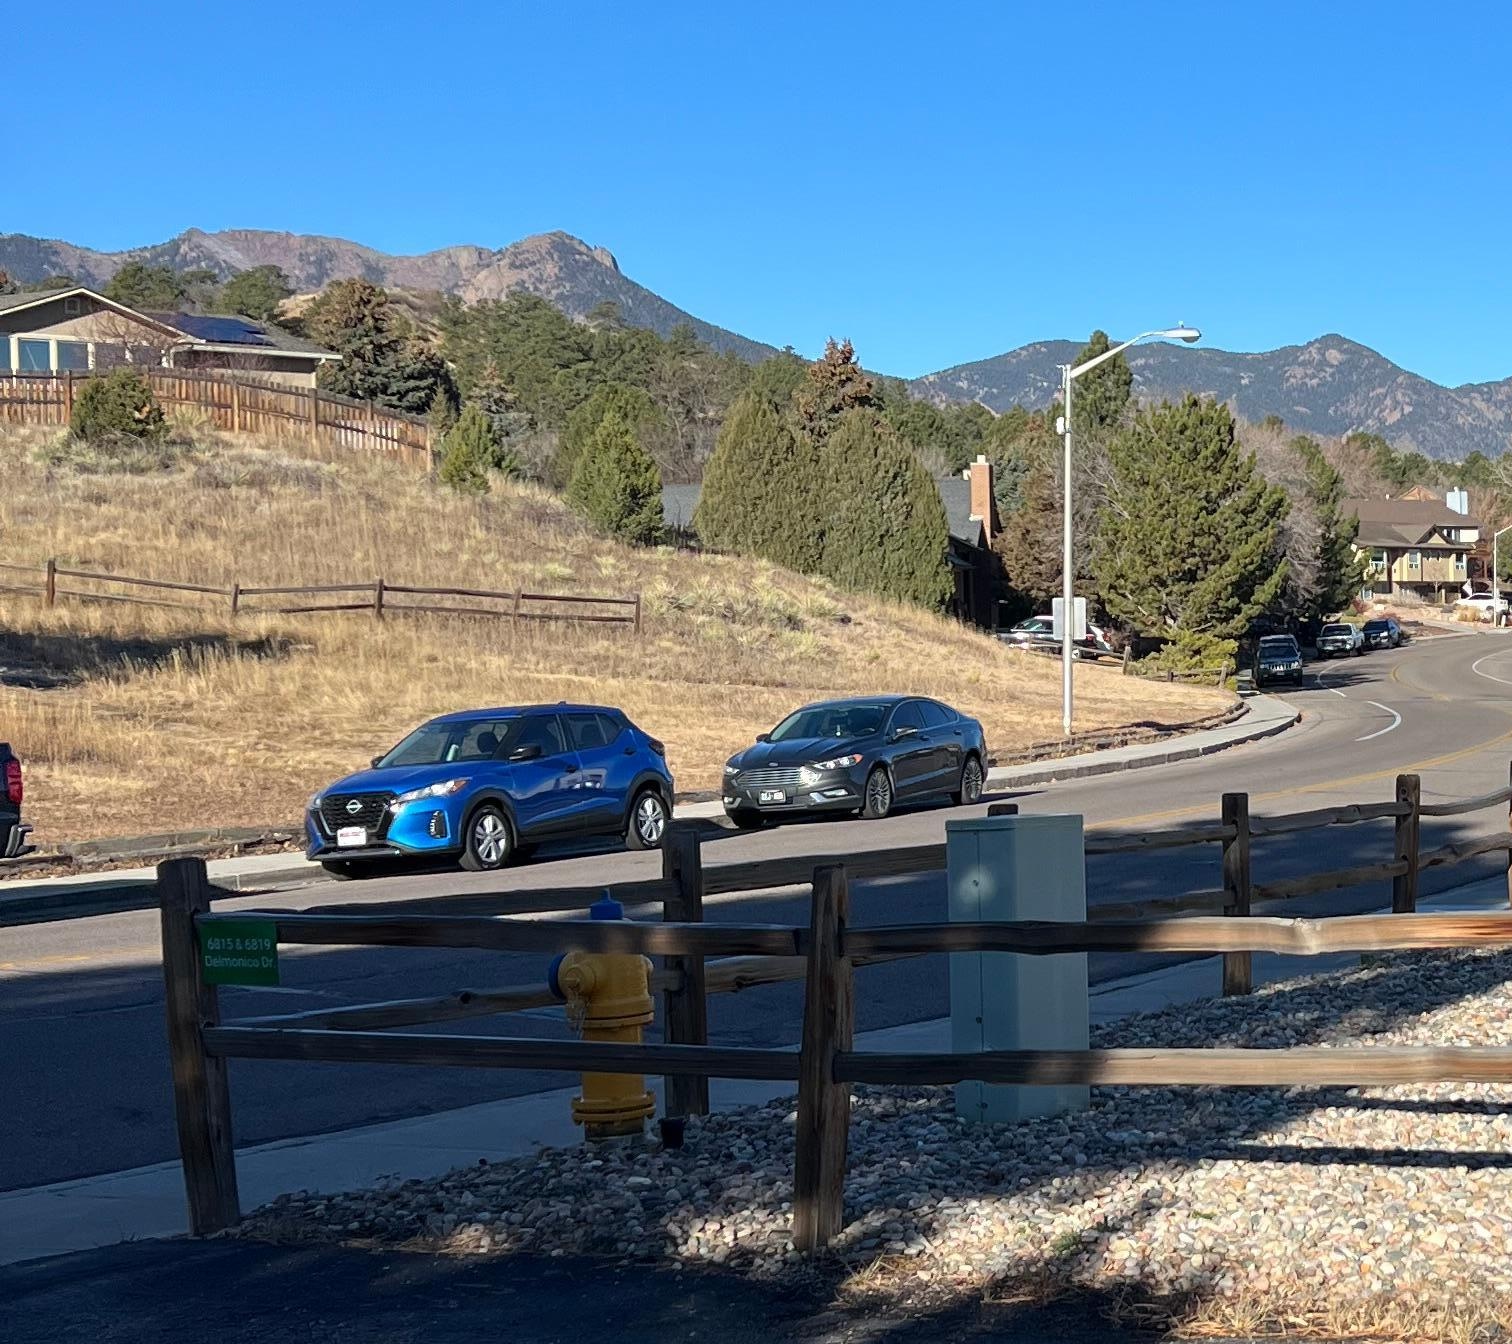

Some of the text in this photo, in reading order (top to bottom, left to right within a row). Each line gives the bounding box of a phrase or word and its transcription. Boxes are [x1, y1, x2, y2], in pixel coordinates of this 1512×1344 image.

[207, 938, 271, 951] 6815 & 6819
[205, 955, 260, 967] Delmonico
